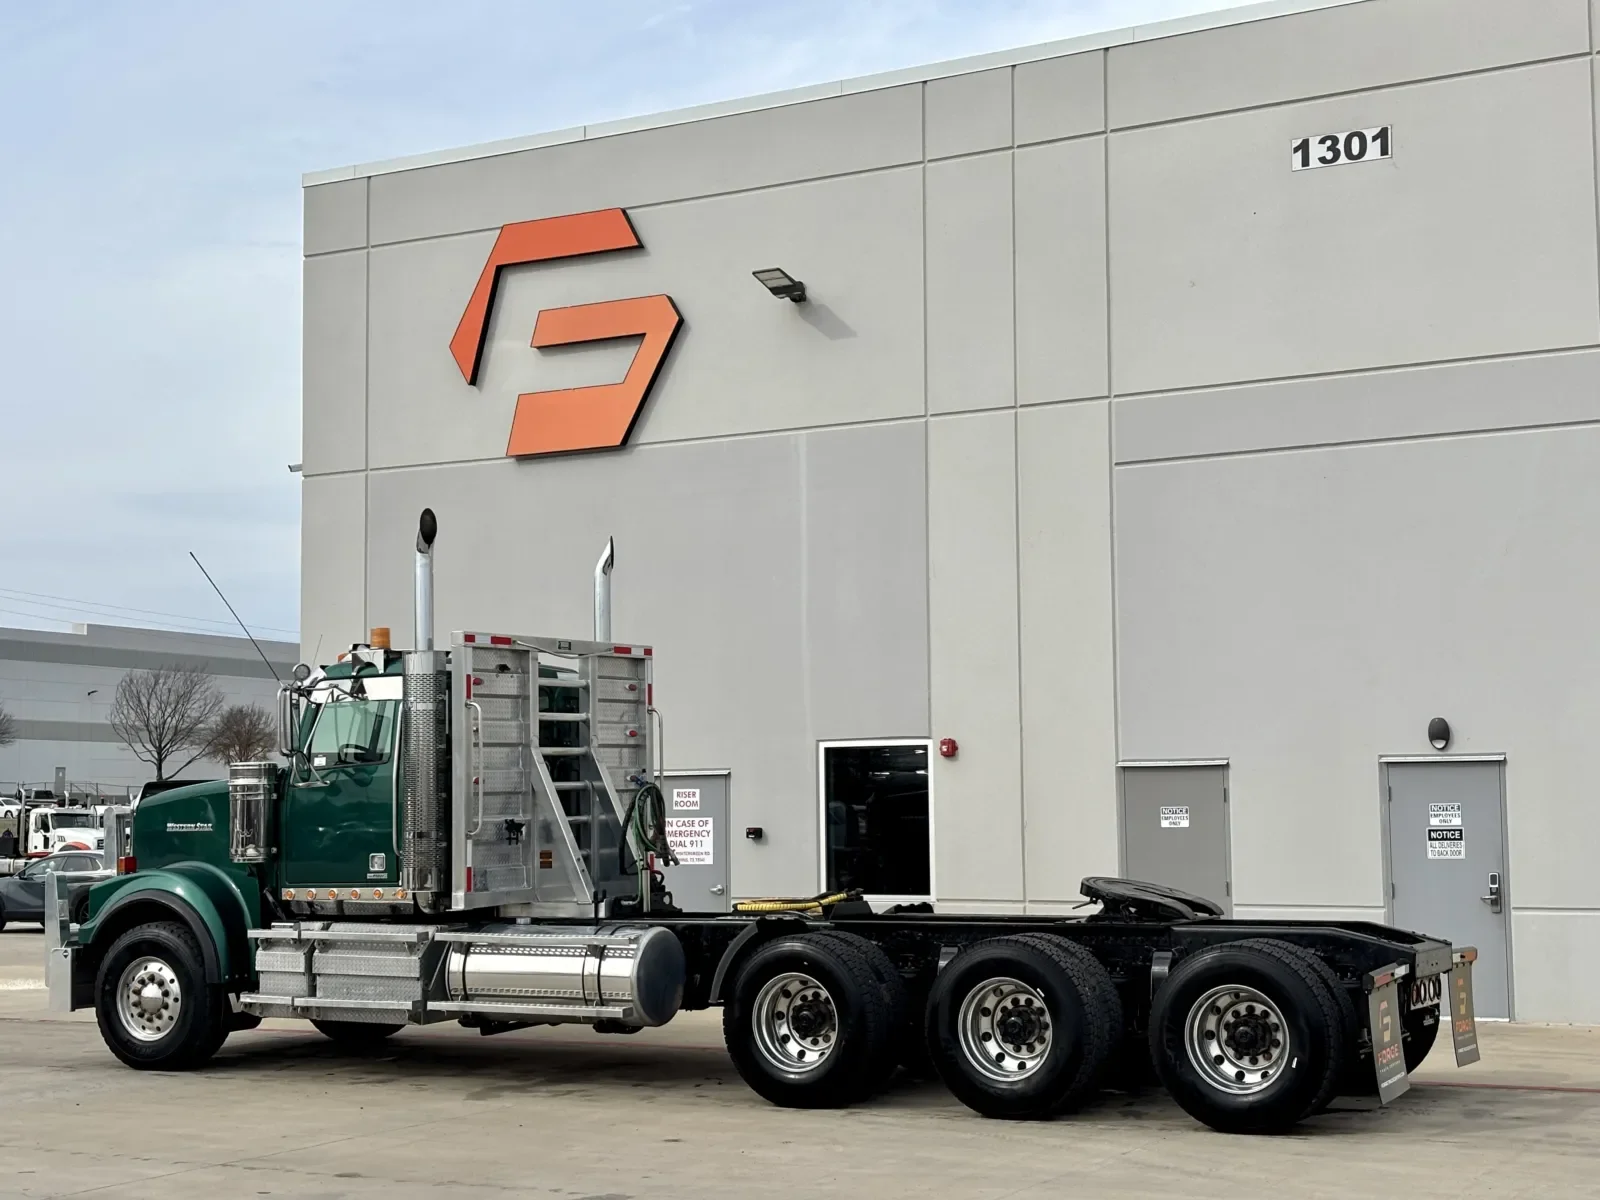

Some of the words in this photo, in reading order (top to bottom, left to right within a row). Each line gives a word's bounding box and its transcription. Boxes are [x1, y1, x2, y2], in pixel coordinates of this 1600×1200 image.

[1293, 126, 1389, 168] 1301
[676, 791, 697, 799] RISER
[674, 800, 699, 808] ROOM
[1431, 804, 1459, 812] NOTICE
[665, 819, 674, 828] N
[675, 819, 696, 828] CASE
[697, 819, 709, 828] OF
[1430, 830, 1461, 839] NOTICE
[669, 839, 688, 848] DIAL
[689, 839, 703, 848] 911
[1429, 841, 1438, 849] ALL
[1438, 841, 1463, 849] DELIVERIES
[1430, 849, 1437, 857] TO
[1437, 849, 1449, 857] BACK
[1449, 849, 1462, 857] DOOR
[1377, 1043, 1399, 1066] FORGE
